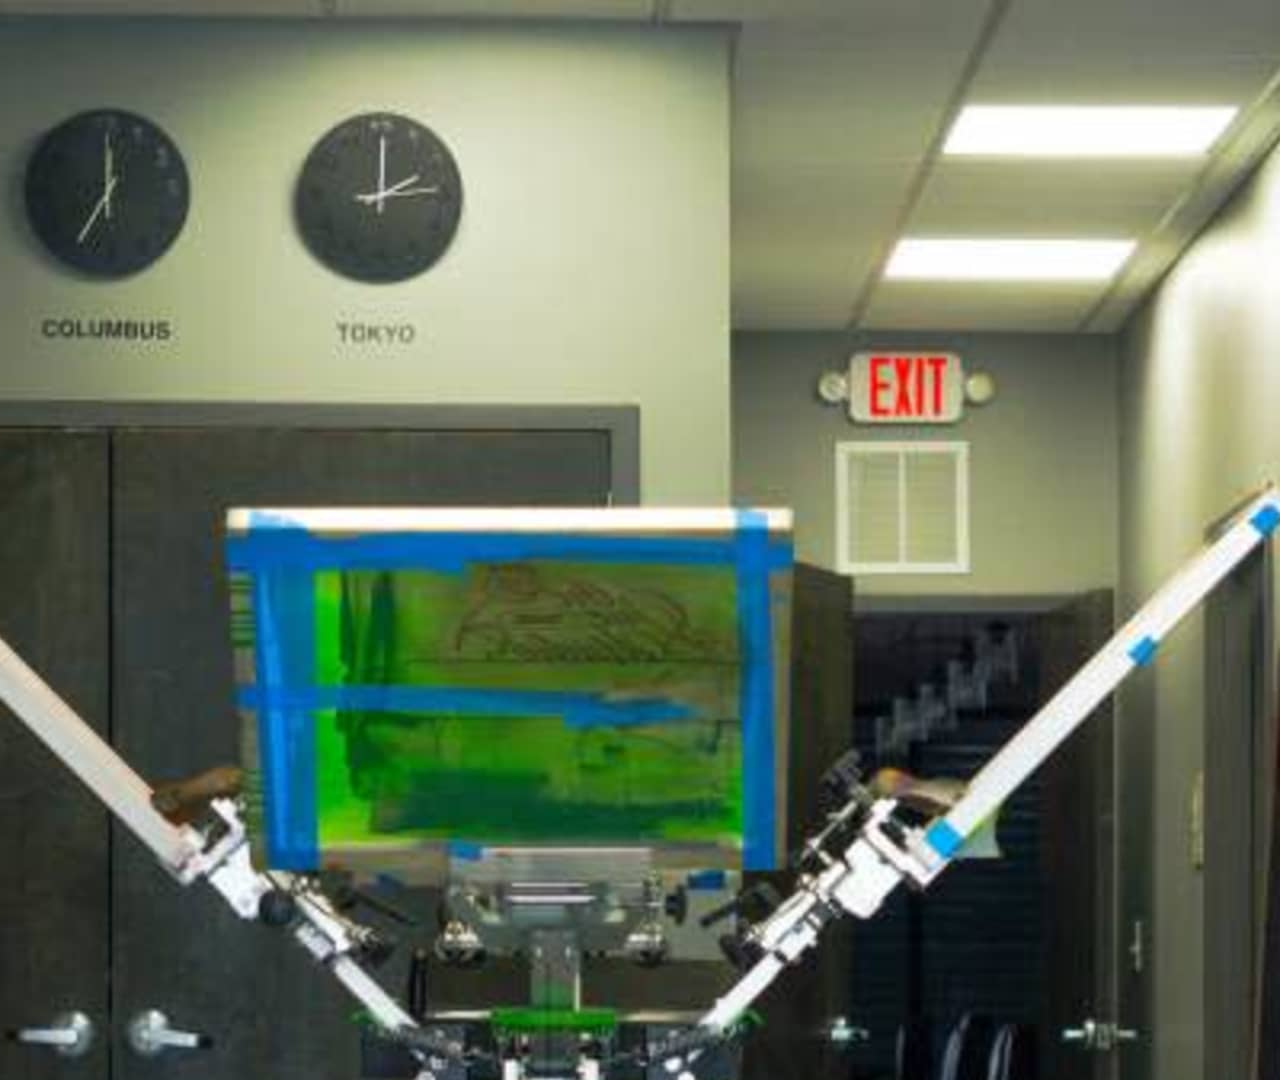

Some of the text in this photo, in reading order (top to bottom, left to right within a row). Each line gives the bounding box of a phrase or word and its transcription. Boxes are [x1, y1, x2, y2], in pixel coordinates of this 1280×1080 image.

[41, 319, 172, 340] COLUMBUS
[336, 323, 416, 343] TOKYO
[870, 356, 948, 416] EXIT
